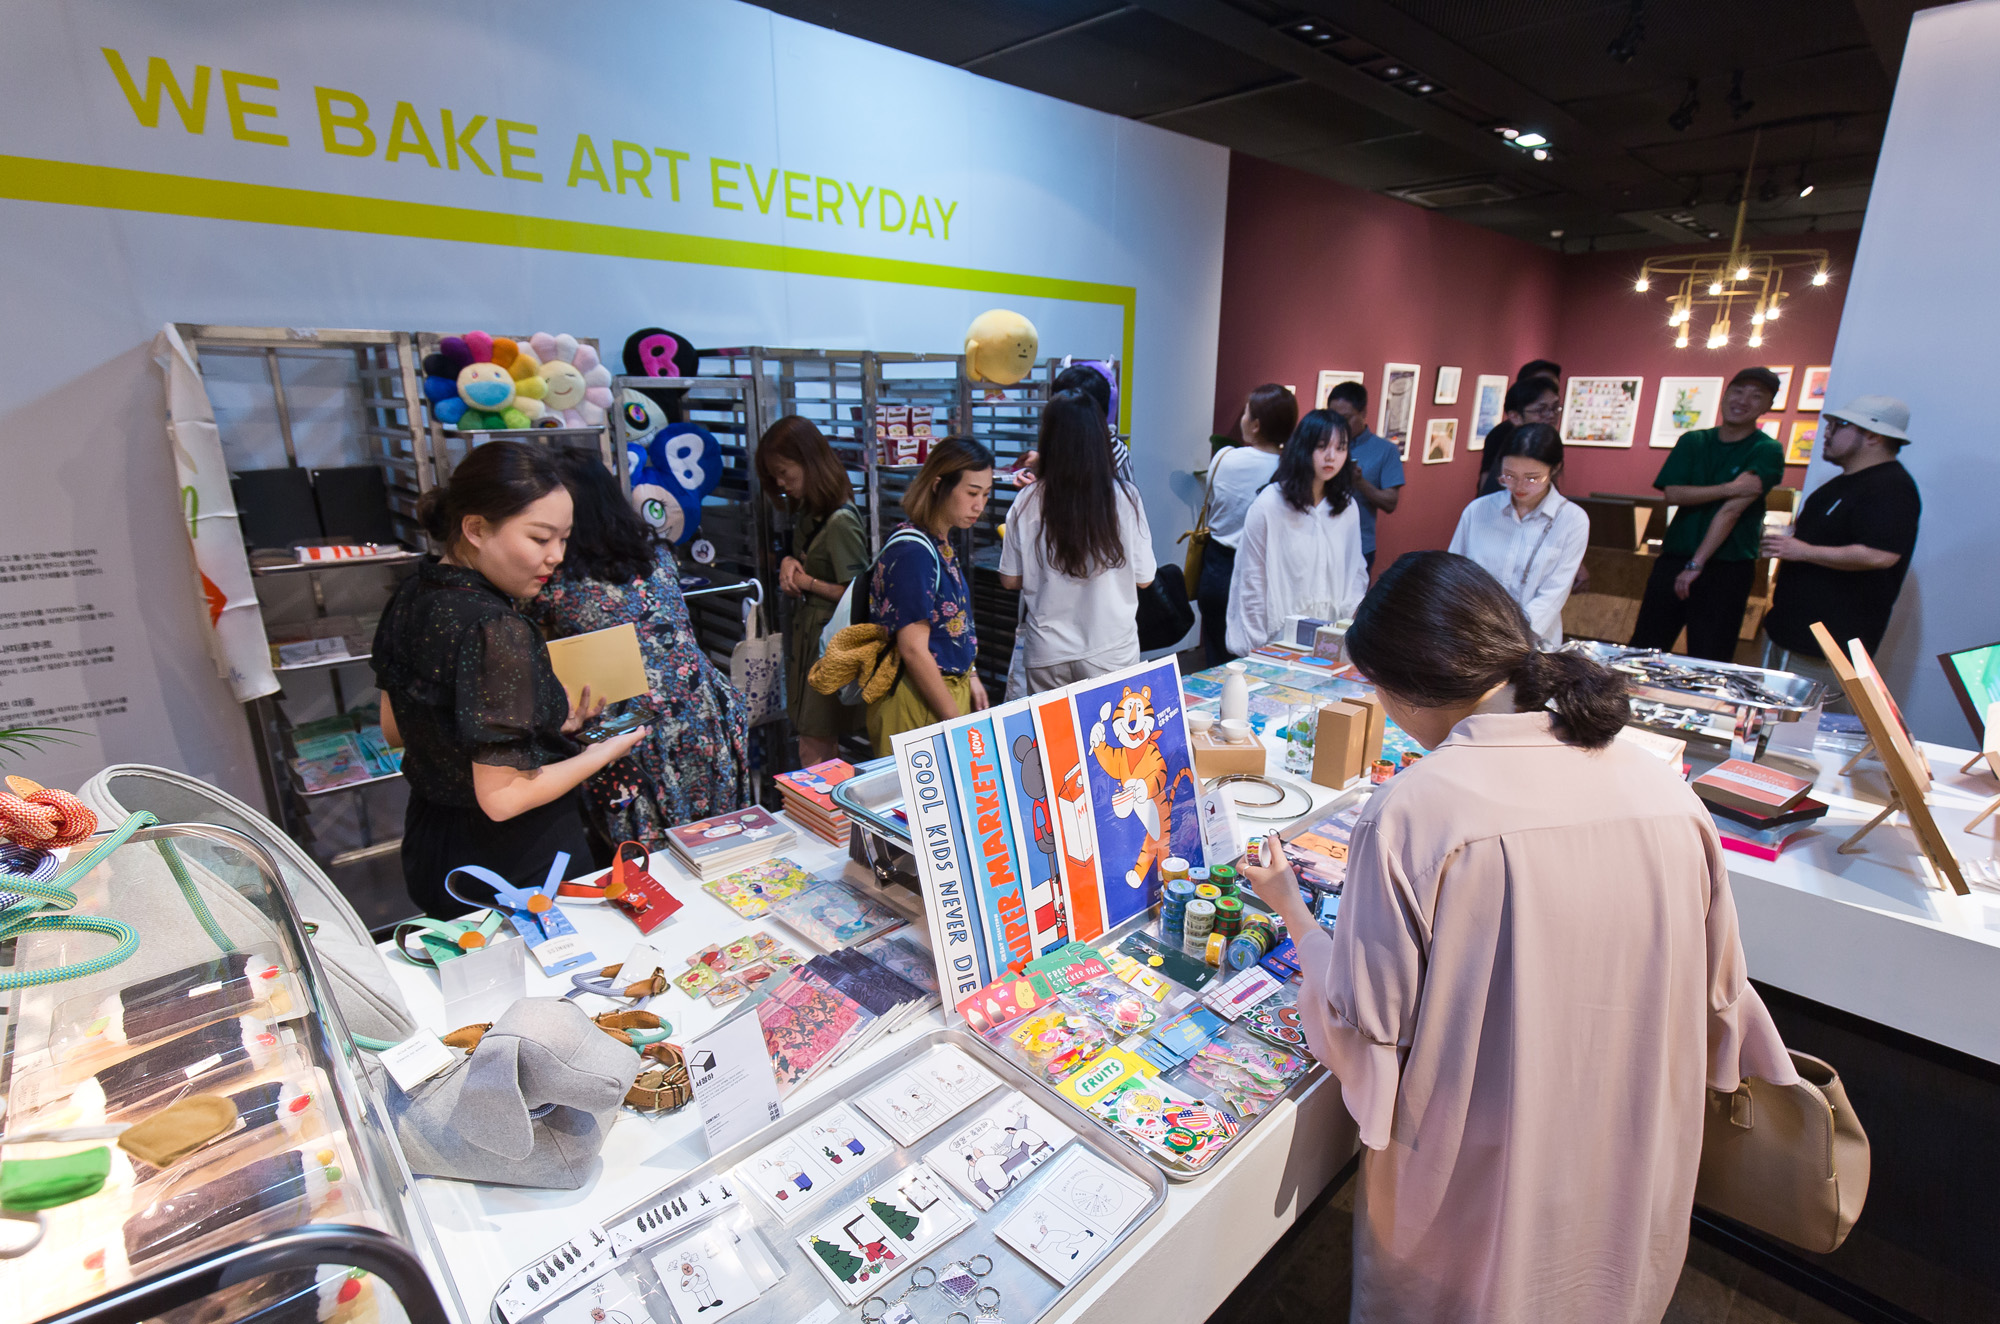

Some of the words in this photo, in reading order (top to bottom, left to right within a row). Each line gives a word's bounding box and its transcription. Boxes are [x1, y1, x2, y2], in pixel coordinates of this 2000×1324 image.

[102, 48, 289, 148] WE
[314, 86, 543, 184] BAKE
[567, 134, 690, 203] ART
[711, 158, 957, 241] EVERYDAY
[664, 432, 706, 491] B
[971, 731, 984, 755] NOW
[910, 748, 945, 815] COOL
[969, 760, 1016, 889] MARKET
[925, 823, 954, 872] KIDS
[938, 880, 968, 946] NEVER
[952, 953, 978, 994] DIE
[1046, 964, 1074, 981] FRESH
[1052, 971, 1085, 990] STICKER
[1085, 964, 1105, 976] PACK
[1081, 1062, 1120, 1093] FRUITS
[705, 1112, 721, 1125] CONTACT
